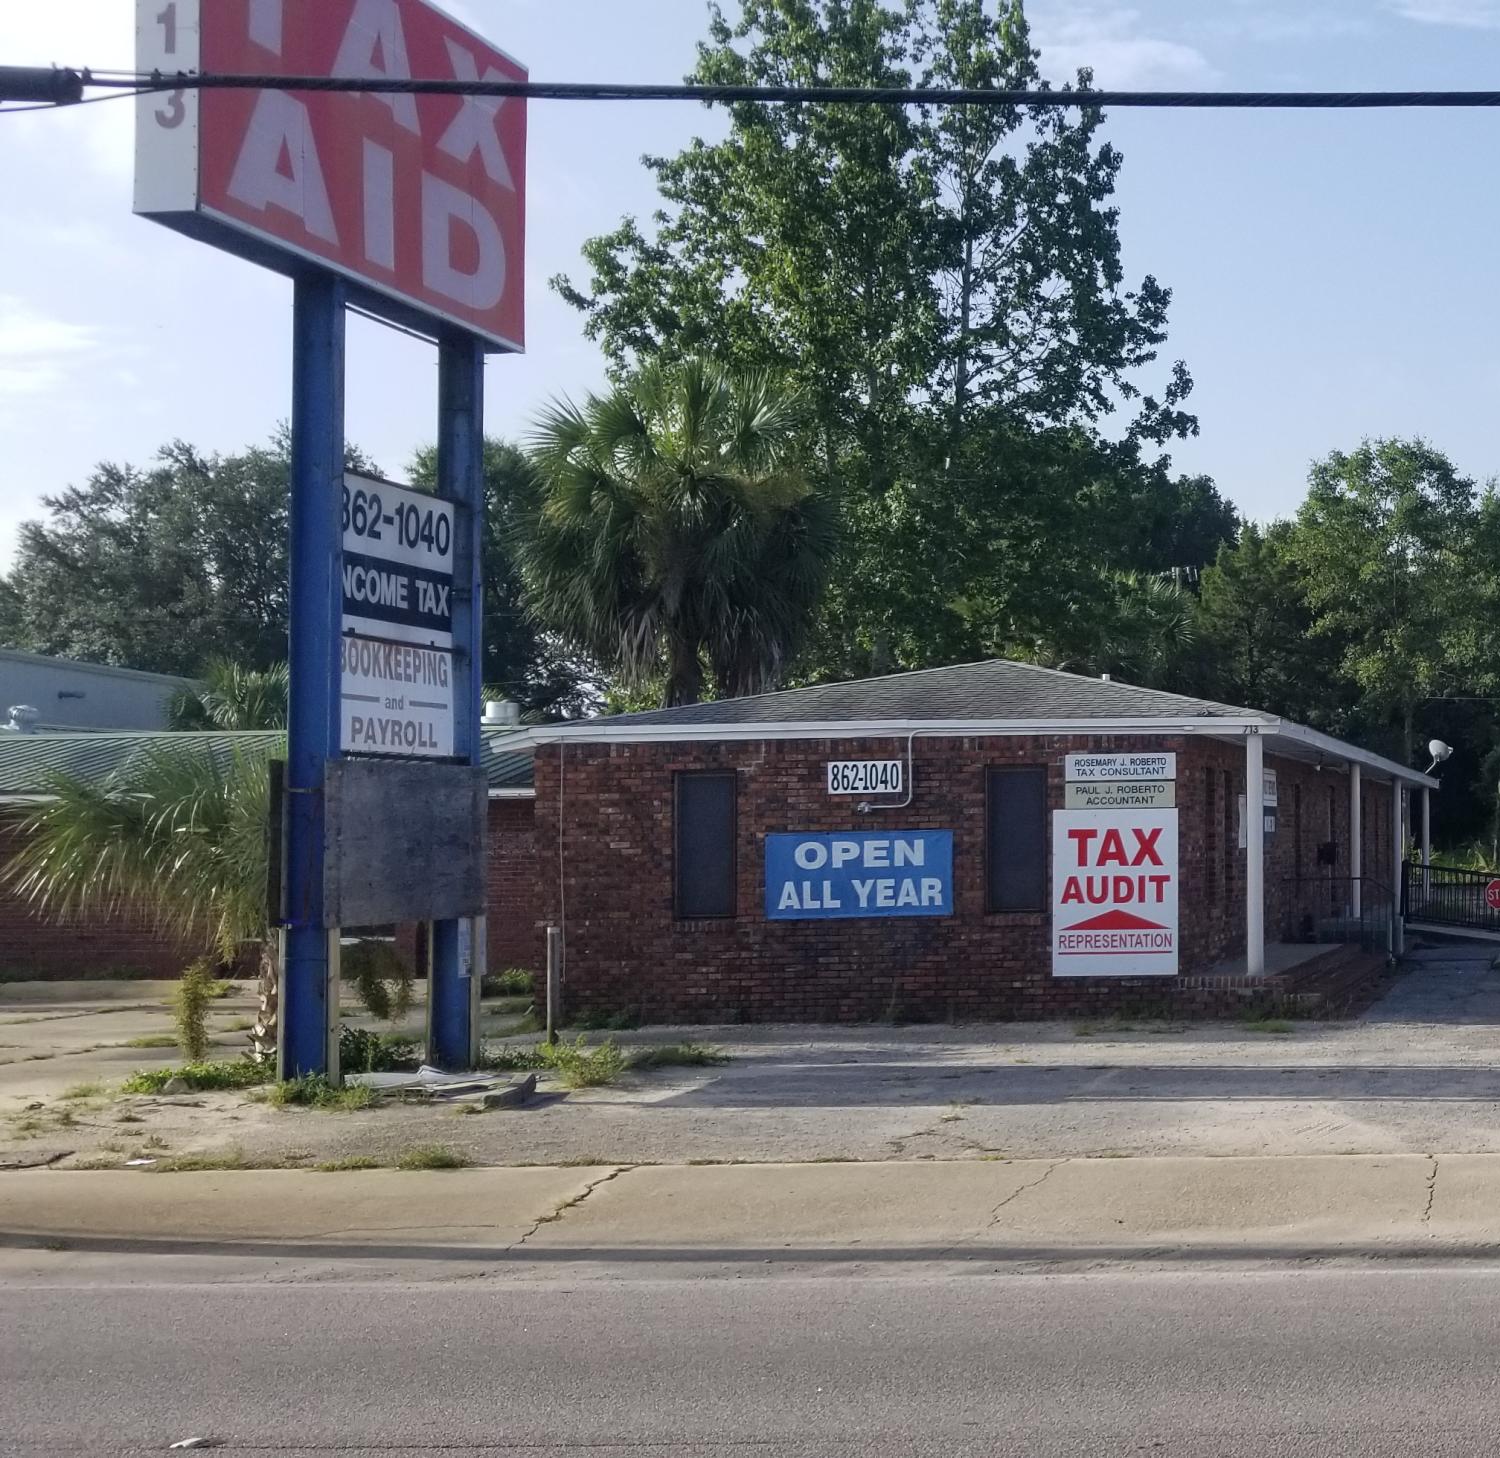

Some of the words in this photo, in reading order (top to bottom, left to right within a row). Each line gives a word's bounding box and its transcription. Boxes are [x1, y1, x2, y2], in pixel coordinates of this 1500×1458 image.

[227, 88, 506, 311] AID
[342, 564, 409, 609] NCOME
[415, 579, 450, 617] TAX
[384, 695, 404, 711] and
[351, 716, 438, 749] PAYROLL
[831, 763, 899, 791] 862-1040
[1074, 758, 1117, 768] ROSEMARY
[1120, 758, 1127, 767] J.
[1130, 757, 1167, 767] ROBERTO
[1075, 768, 1096, 777] TAX
[1100, 766, 1166, 776] CONSULTANT
[1075, 786, 1100, 795] PAUL
[1105, 786, 1113, 795] J.
[1117, 784, 1165, 794] ROBERTO
[1086, 796, 1155, 805] ACCOUNTANT
[794, 839, 925, 870] OPEN
[1067, 828, 1164, 867] TAX
[777, 880, 841, 910] ALL
[851, 877, 943, 908] YEAR
[1060, 875, 1171, 905] AUDIT
[1058, 933, 1173, 949] REPRESENTATION
